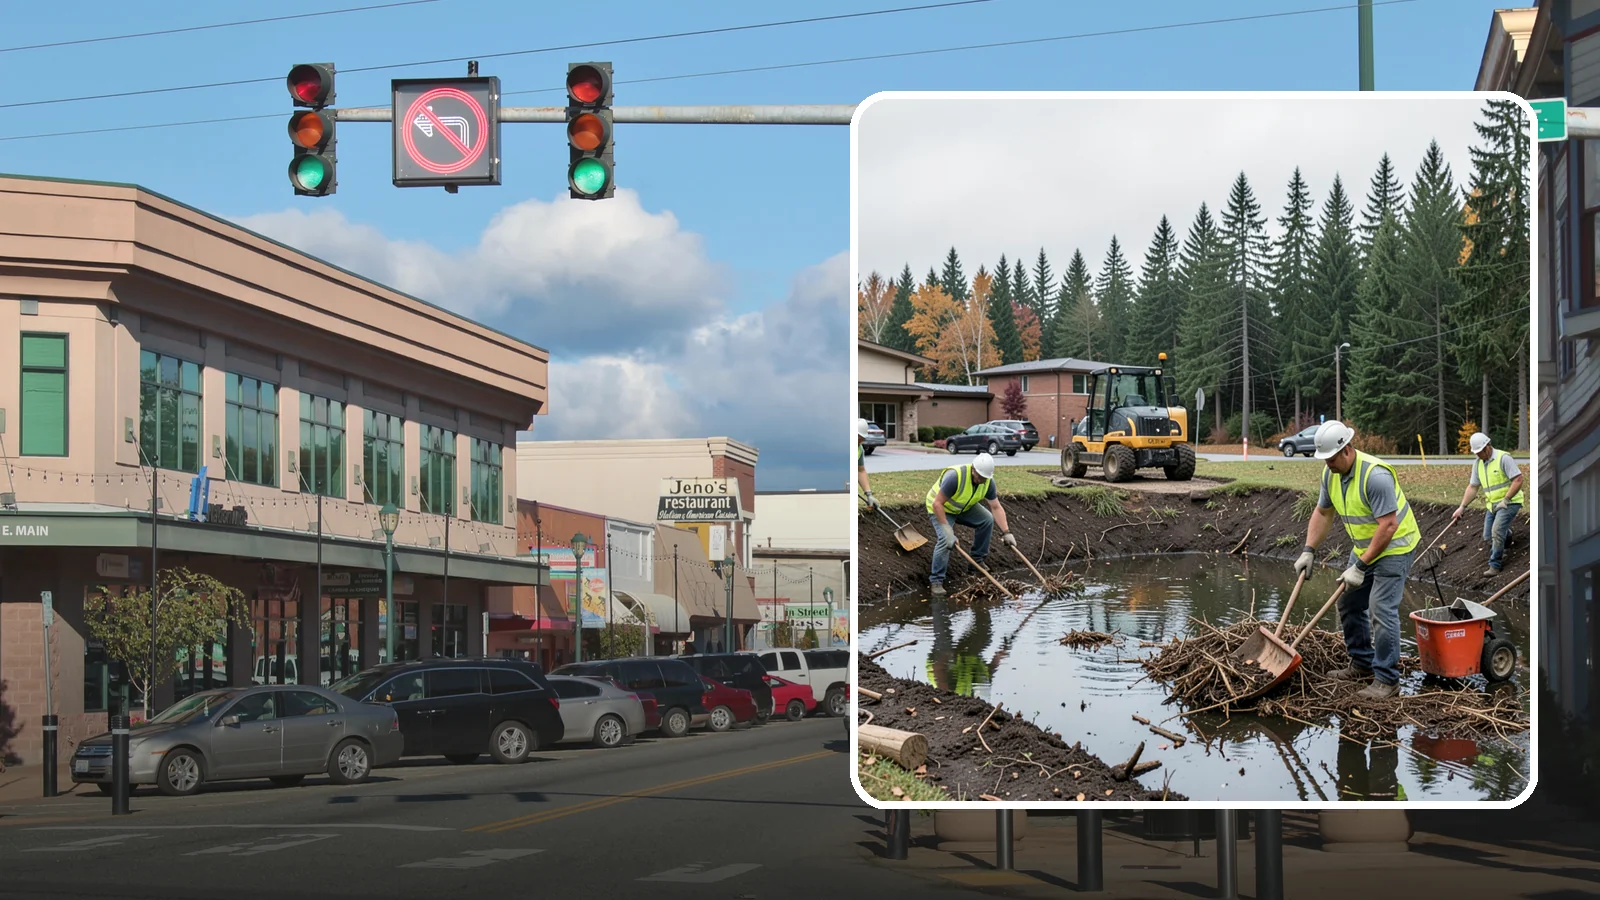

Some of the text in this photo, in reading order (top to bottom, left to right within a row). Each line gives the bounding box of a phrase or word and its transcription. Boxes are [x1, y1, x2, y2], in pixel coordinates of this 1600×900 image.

[669, 480, 728, 494] Jeno's
[664, 496, 731, 509] restaurant
[658, 509, 682, 519] Italian
[686, 509, 715, 519] American
[715, 509, 738, 519] Cuisine
[2, 525, 49, 536] E. MAIN
[797, 607, 829, 616] Street
